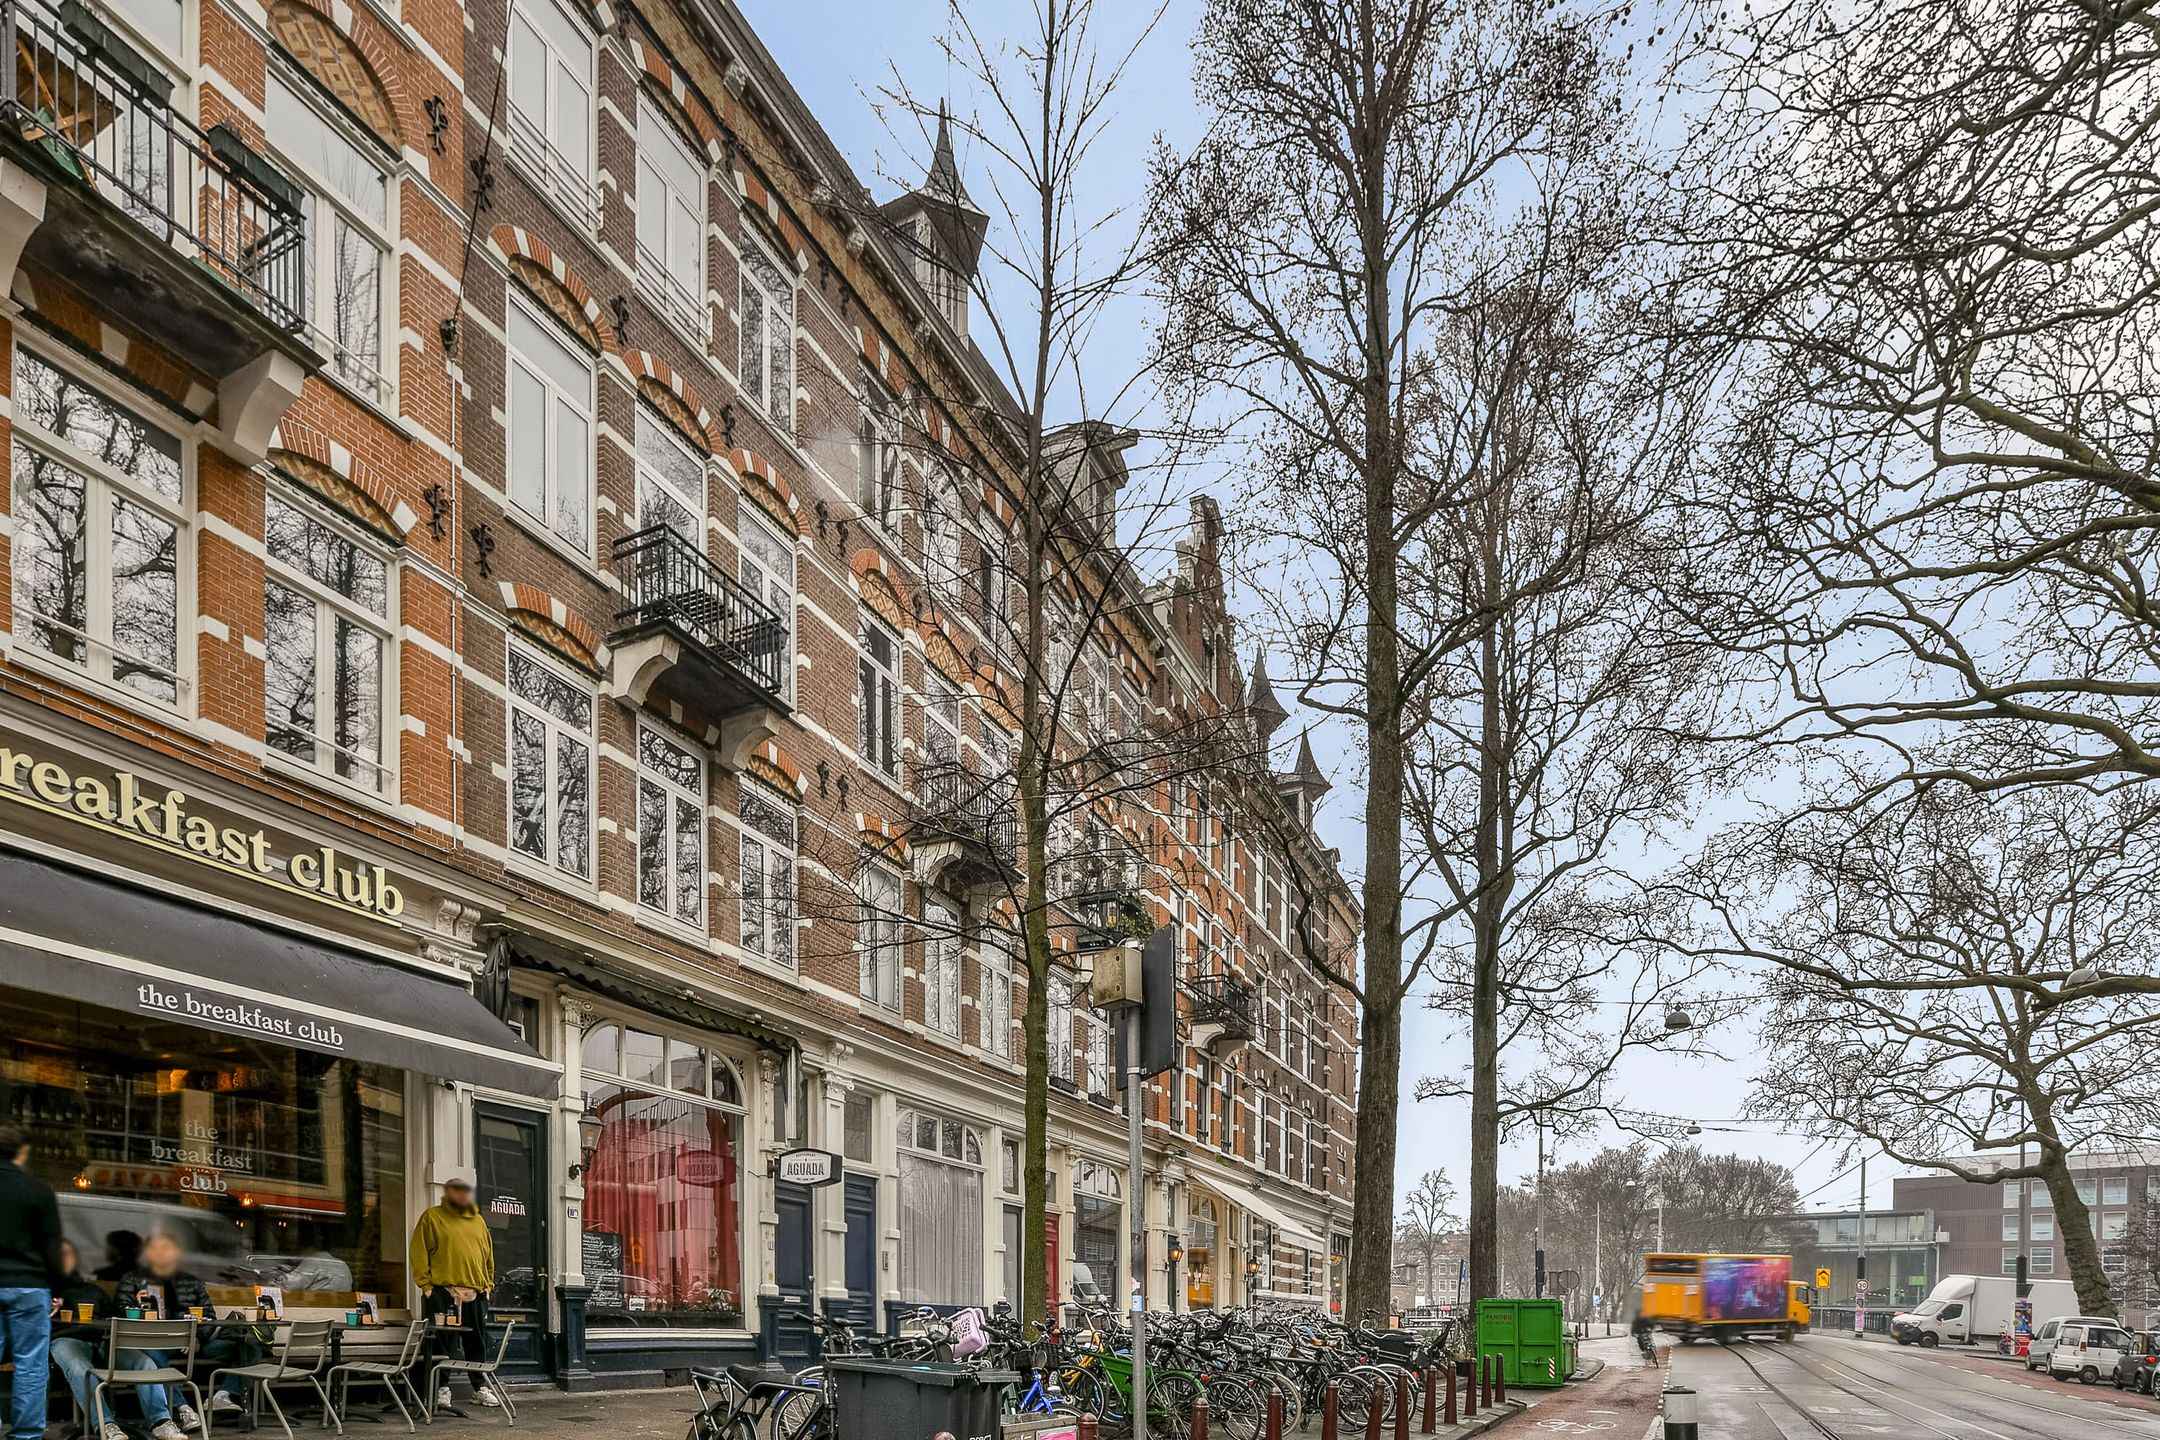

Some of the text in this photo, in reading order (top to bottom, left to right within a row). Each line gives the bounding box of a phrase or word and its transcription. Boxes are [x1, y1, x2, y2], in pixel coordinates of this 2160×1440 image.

[0, 748, 404, 916] reakfast club
[137, 984, 344, 1046] the breakfast club
[184, 1119, 219, 1140] the
[150, 1139, 253, 1170] breakfast
[787, 1162, 825, 1176] AGUADA
[180, 1171, 227, 1192] club
[491, 1201, 526, 1216] AGUADA
